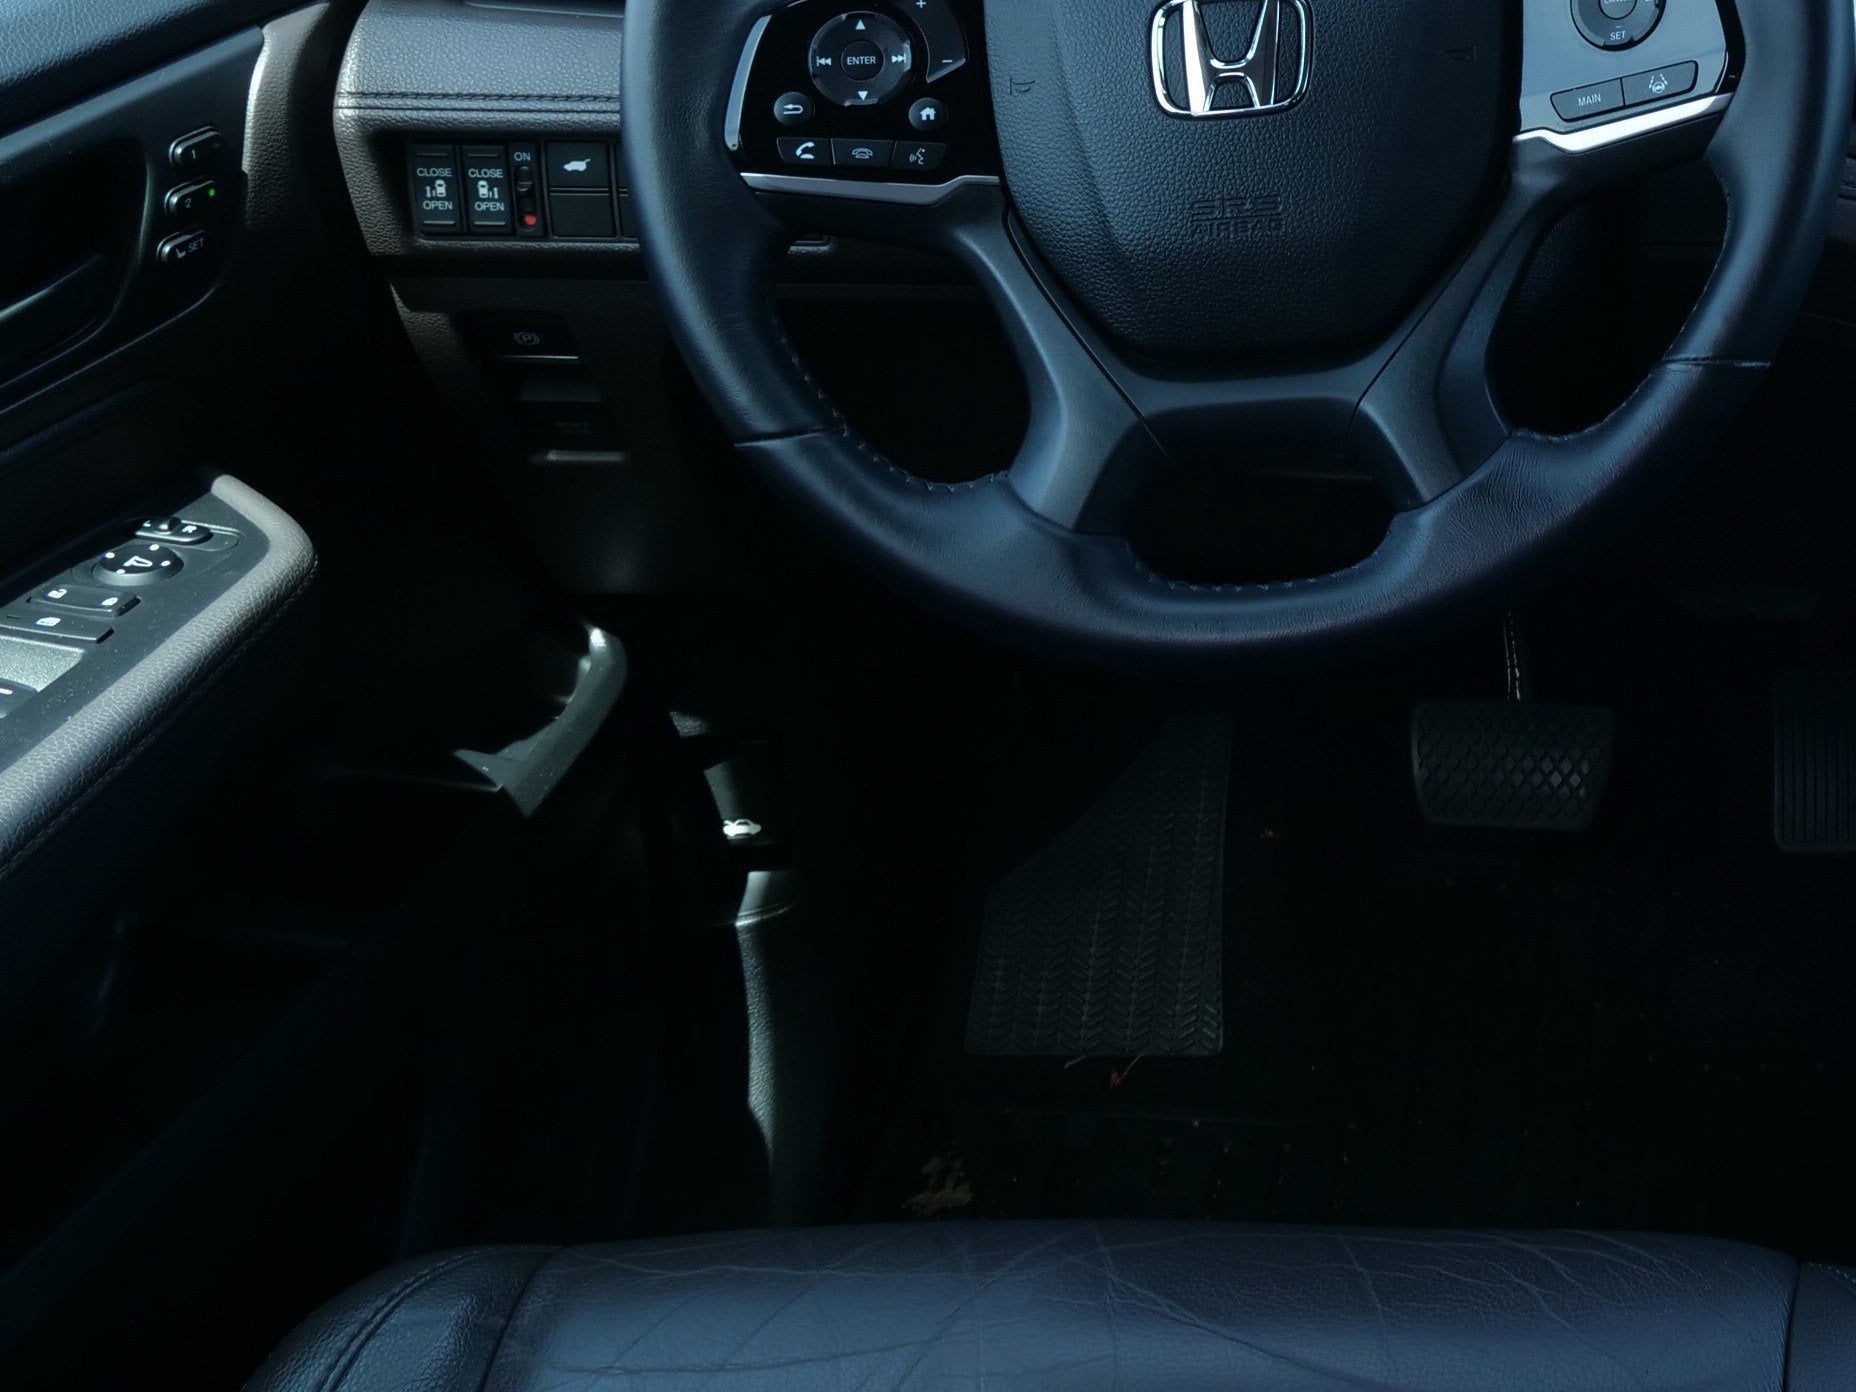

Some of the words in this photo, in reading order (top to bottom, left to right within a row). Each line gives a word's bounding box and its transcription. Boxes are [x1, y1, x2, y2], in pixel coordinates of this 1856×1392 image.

[1610, 31, 1627, 41] SET
[846, 55, 877, 66] ENTER
[1578, 93, 1602, 107] MAIN
[513, 151, 531, 162] ON
[416, 167, 453, 178] CLOSE
[468, 168, 504, 179] CLOSE
[184, 198, 192, 209] 2
[422, 200, 453, 210] OPEN
[474, 201, 505, 211] OPEN
[1190, 194, 1282, 222] SRS
[188, 236, 205, 253] SET
